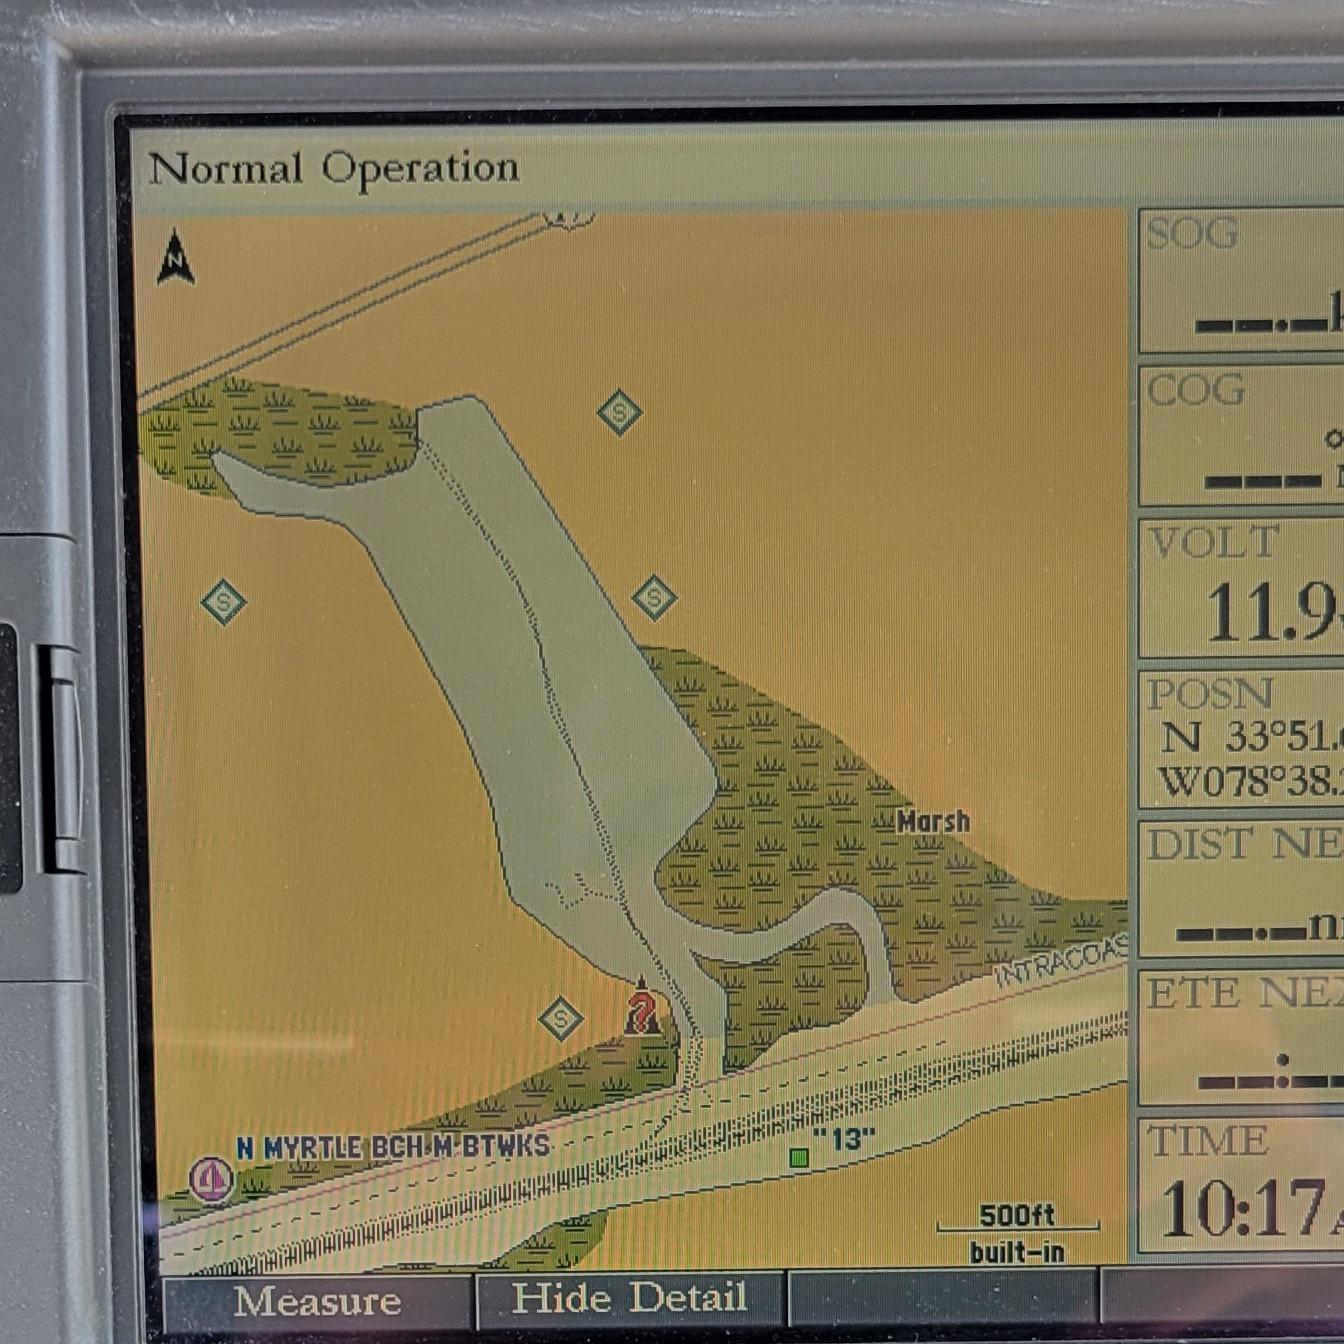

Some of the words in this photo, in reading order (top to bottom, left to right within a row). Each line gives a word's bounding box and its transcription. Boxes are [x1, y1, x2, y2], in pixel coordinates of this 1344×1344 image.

[148, 150, 304, 186] Normal
[322, 149, 521, 196] Operation
[1146, 216, 1240, 250] SOG
[1146, 372, 1247, 406] COG
[1147, 523, 1281, 559] VOLT
[1147, 676, 1276, 710] POSN
[1161, 721, 1202, 753] N
[897, 809, 970, 833] Marsh
[1147, 826, 1254, 861] DIST
[1146, 976, 1242, 1010] ETE
[236, 1136, 253, 1160] N
[264, 1135, 362, 1160] MYRTLE
[372, 1135, 423, 1159] BCH
[463, 1133, 551, 1158] BTWKS
[1146, 1124, 1270, 1158] TIME
[980, 1203, 1055, 1227] 500ft
[970, 1240, 1065, 1264] built-in
[233, 1284, 403, 1317] Measure
[512, 1281, 612, 1314] Hide
[629, 1280, 748, 1314] Detail
